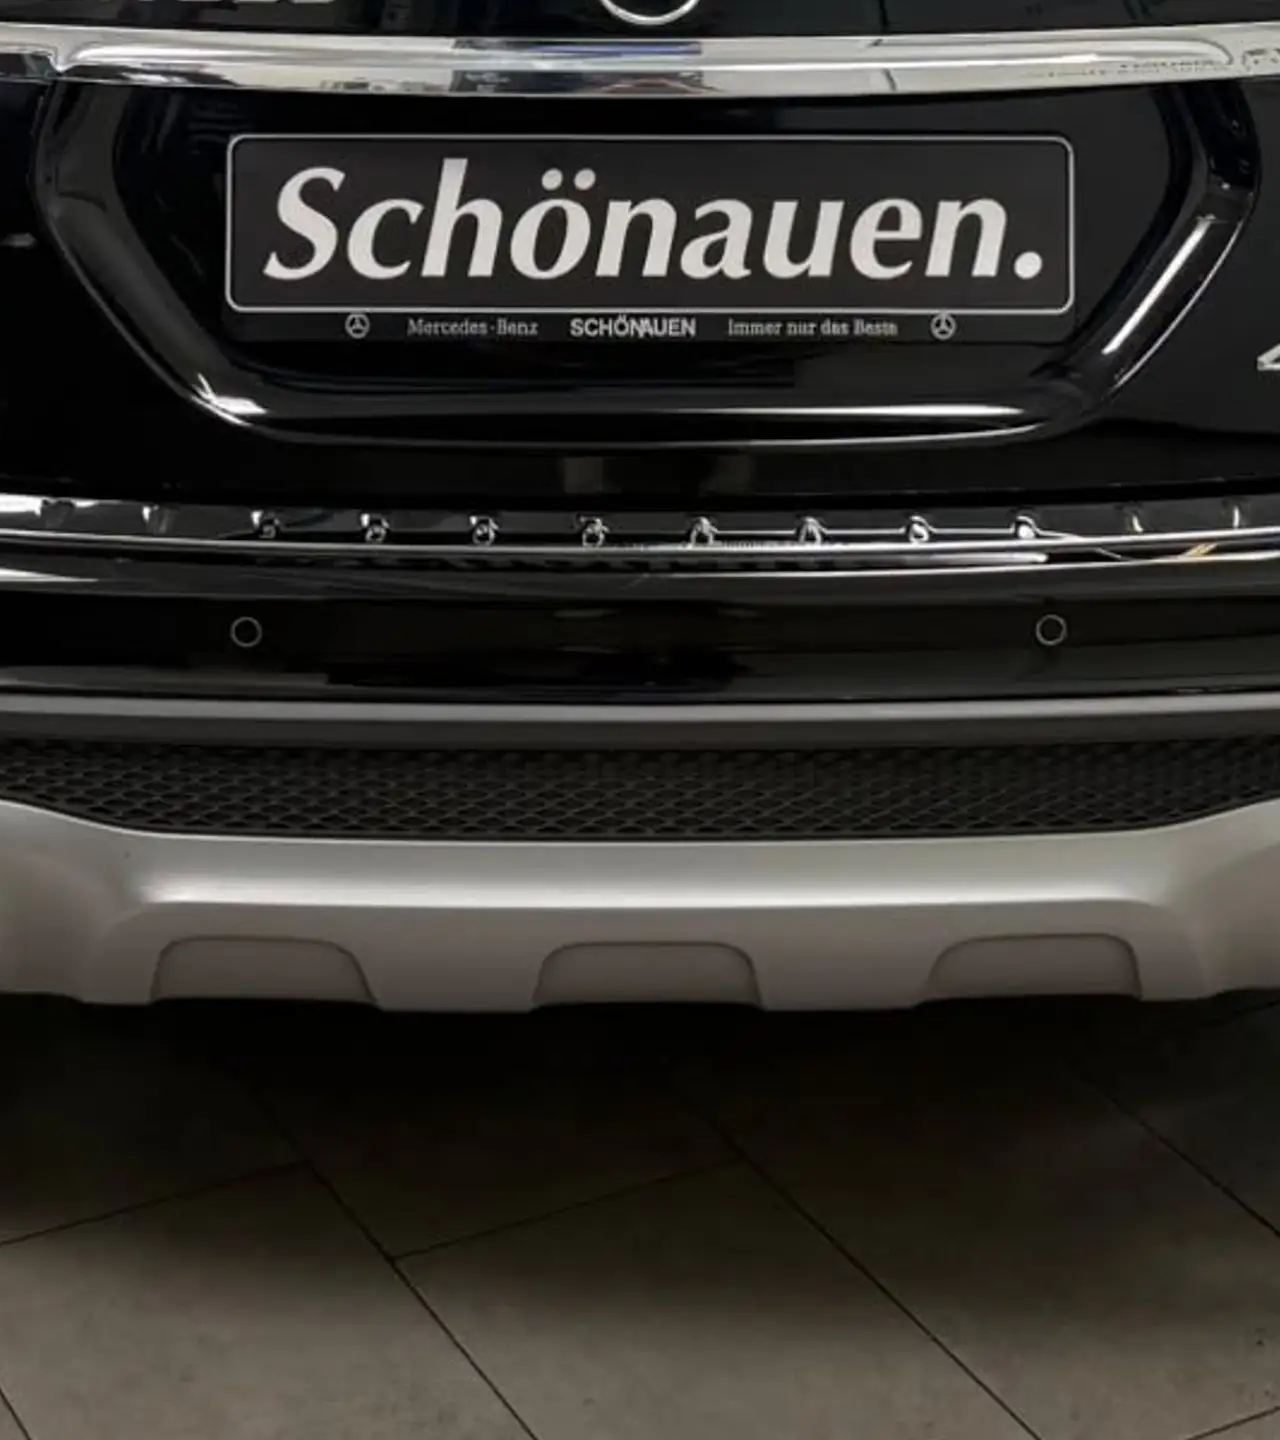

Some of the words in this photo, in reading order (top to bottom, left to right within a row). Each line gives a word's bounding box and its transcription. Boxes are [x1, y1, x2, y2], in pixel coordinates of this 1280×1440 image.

[263, 157, 1044, 281] Schönauen.
[570, 314, 696, 339] SCHÖNAUEN
[728, 318, 783, 336] Immer
[787, 320, 818, 336] nur
[821, 318, 850, 336] das
[853, 318, 898, 336] Beste
